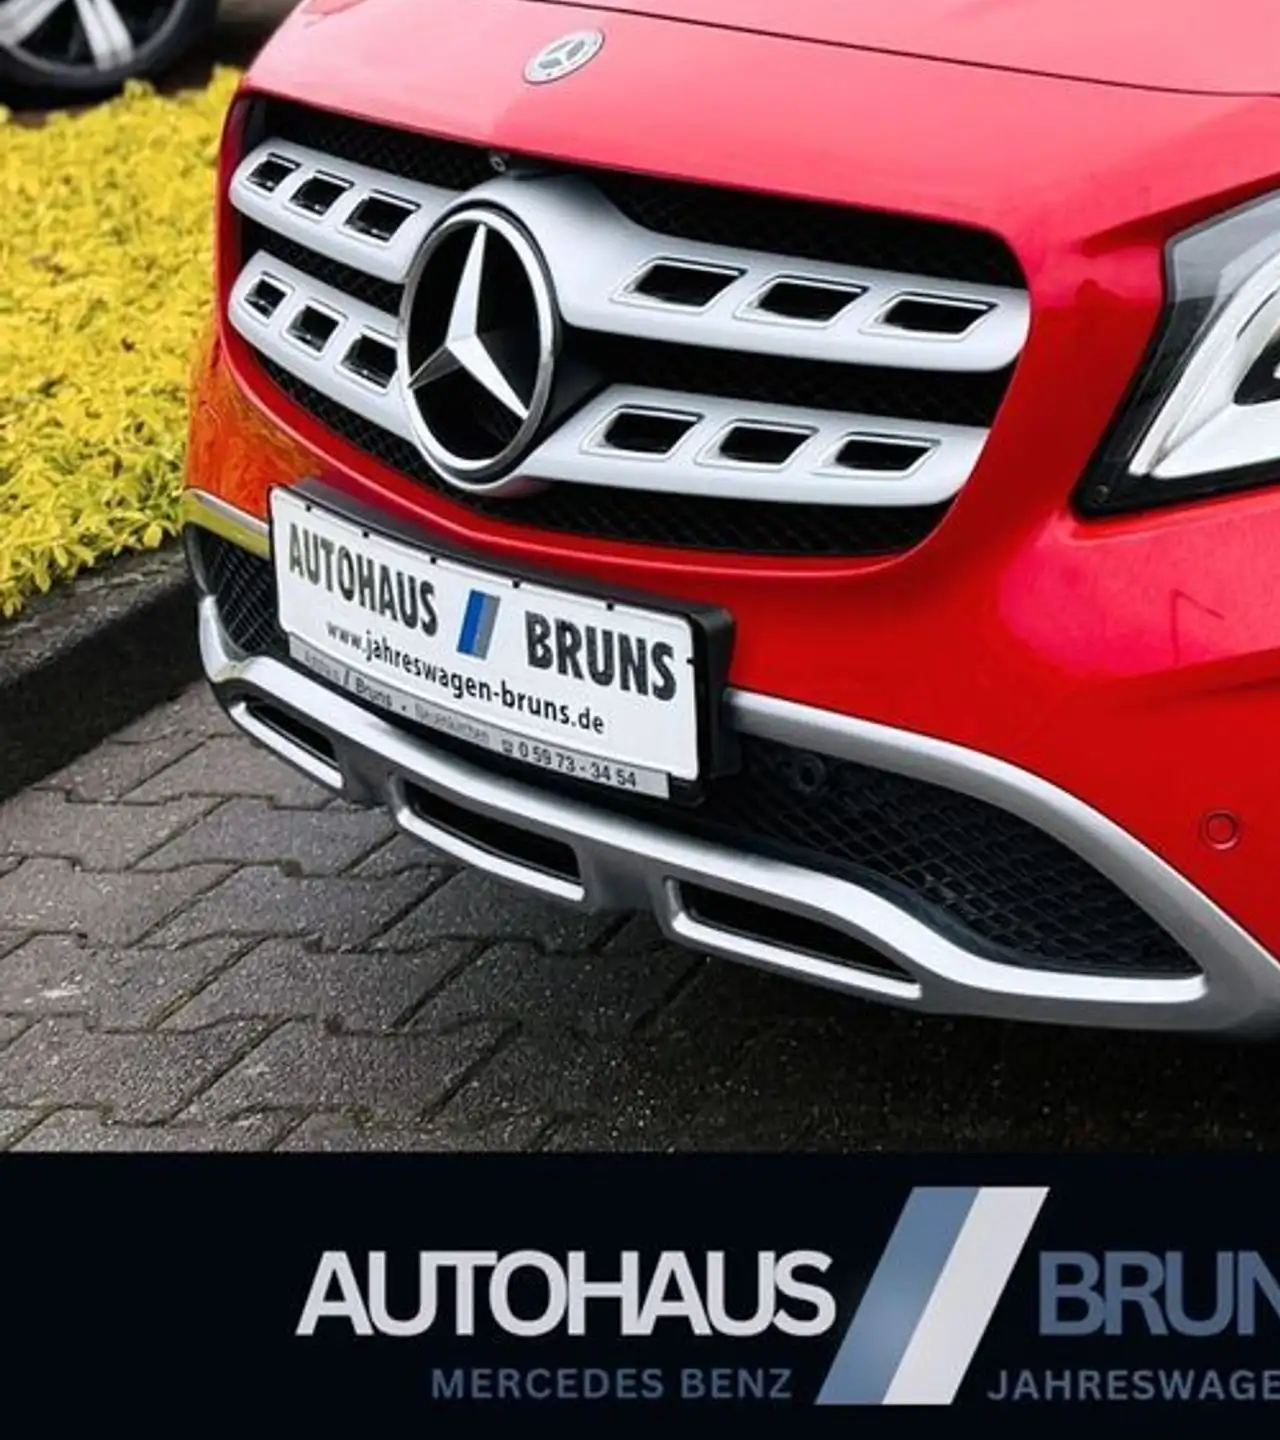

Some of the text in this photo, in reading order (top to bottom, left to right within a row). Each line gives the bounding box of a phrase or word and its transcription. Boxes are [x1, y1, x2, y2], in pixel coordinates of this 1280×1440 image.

[289, 522, 677, 702] AUTOHAUS BRUNS
[326, 620, 605, 735] www.jahreswagen-bruns.de
